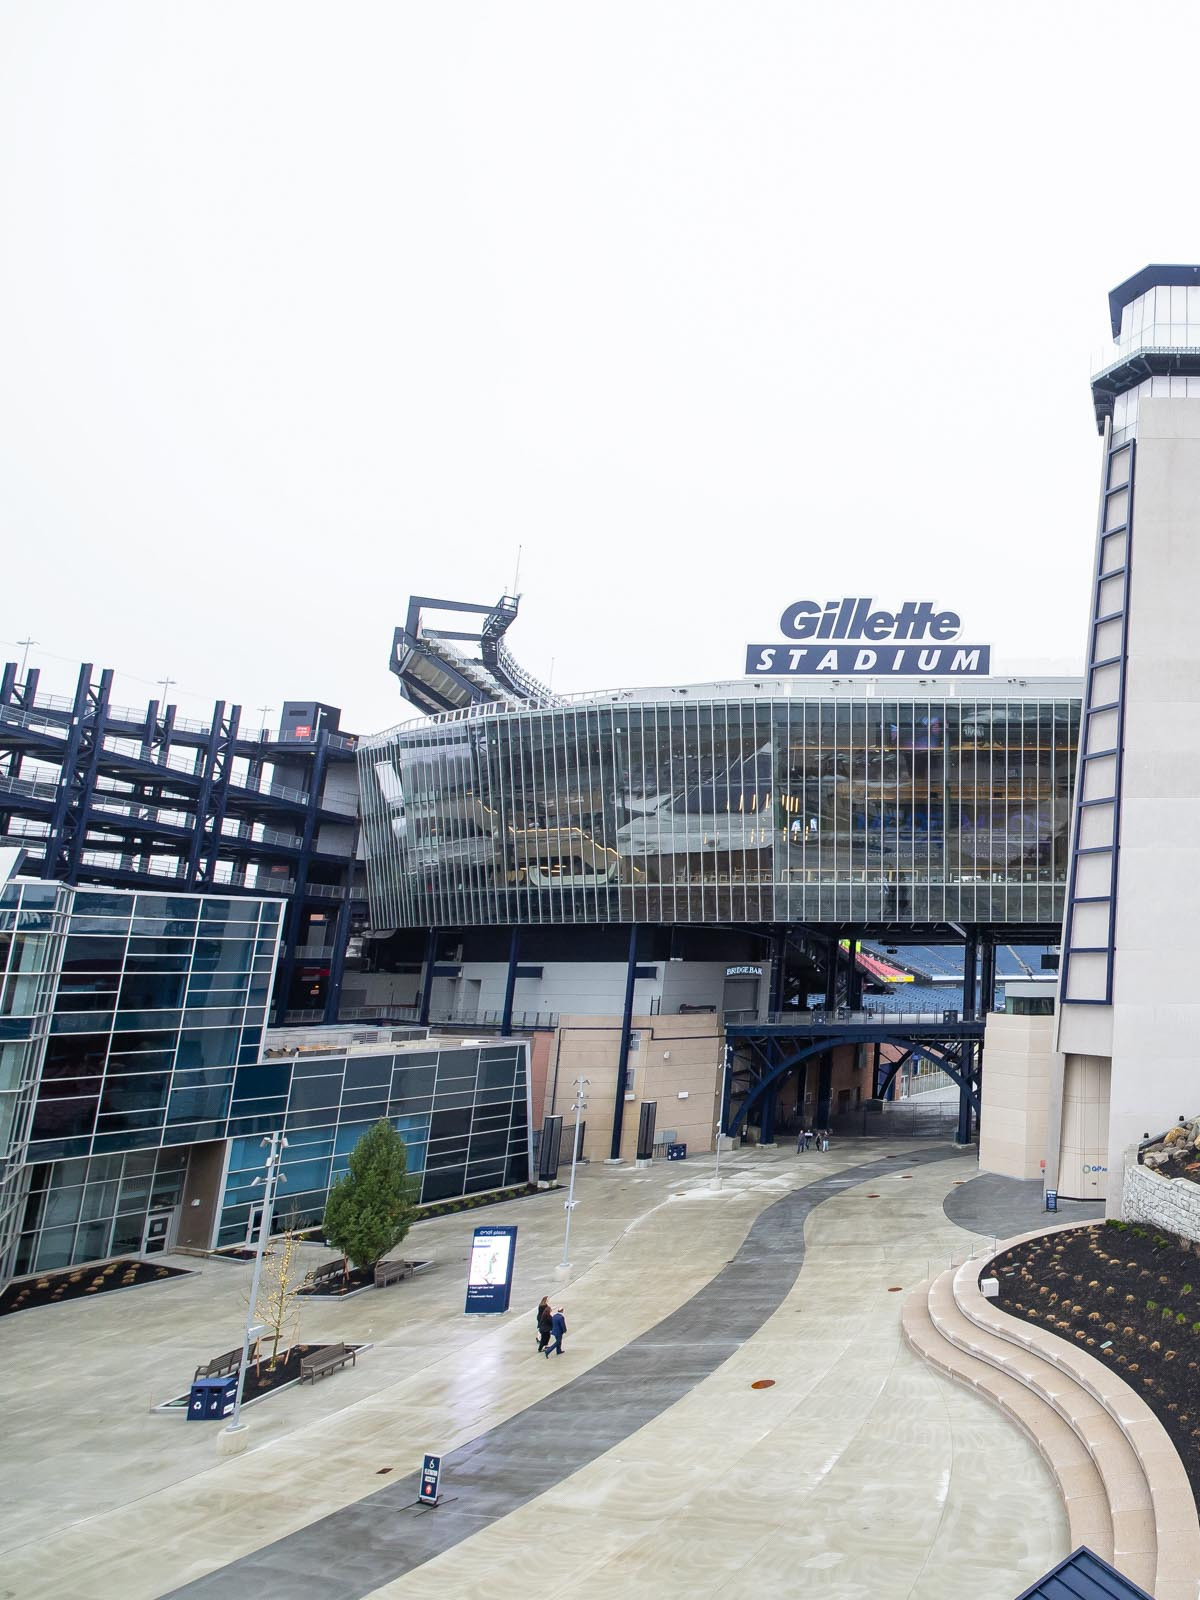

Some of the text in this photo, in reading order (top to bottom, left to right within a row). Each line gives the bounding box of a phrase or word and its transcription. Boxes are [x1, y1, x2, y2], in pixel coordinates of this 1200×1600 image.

[780, 598, 960, 640] Gillette
[756, 649, 980, 671] STADIUM
[726, 966, 762, 975] BRIDGE BAR
